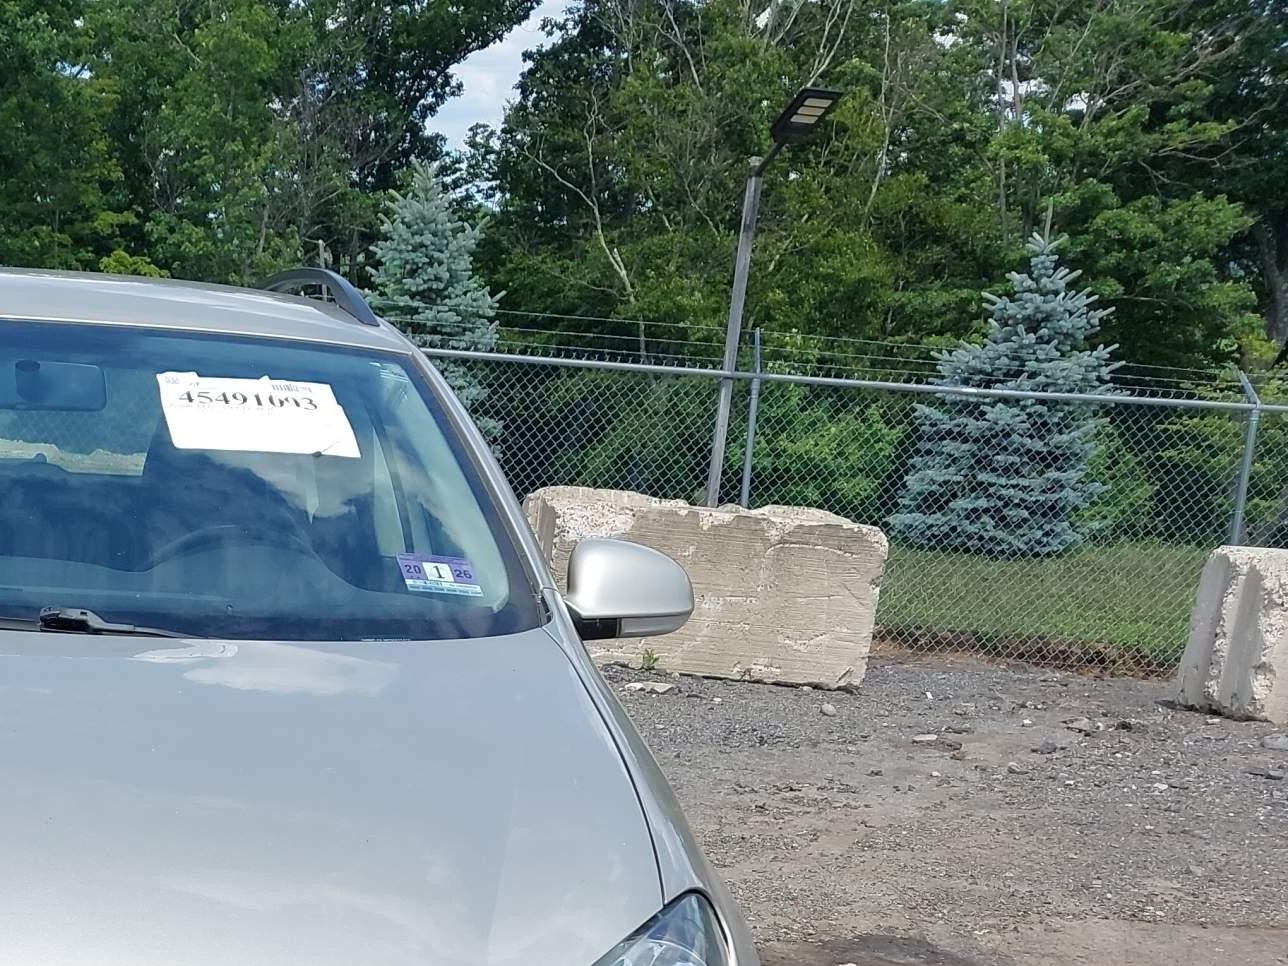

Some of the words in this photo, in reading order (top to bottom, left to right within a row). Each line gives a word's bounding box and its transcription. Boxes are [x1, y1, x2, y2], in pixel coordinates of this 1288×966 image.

[404, 564, 422, 575] 20
[433, 565, 445, 579] 1
[454, 569, 472, 580] 26
